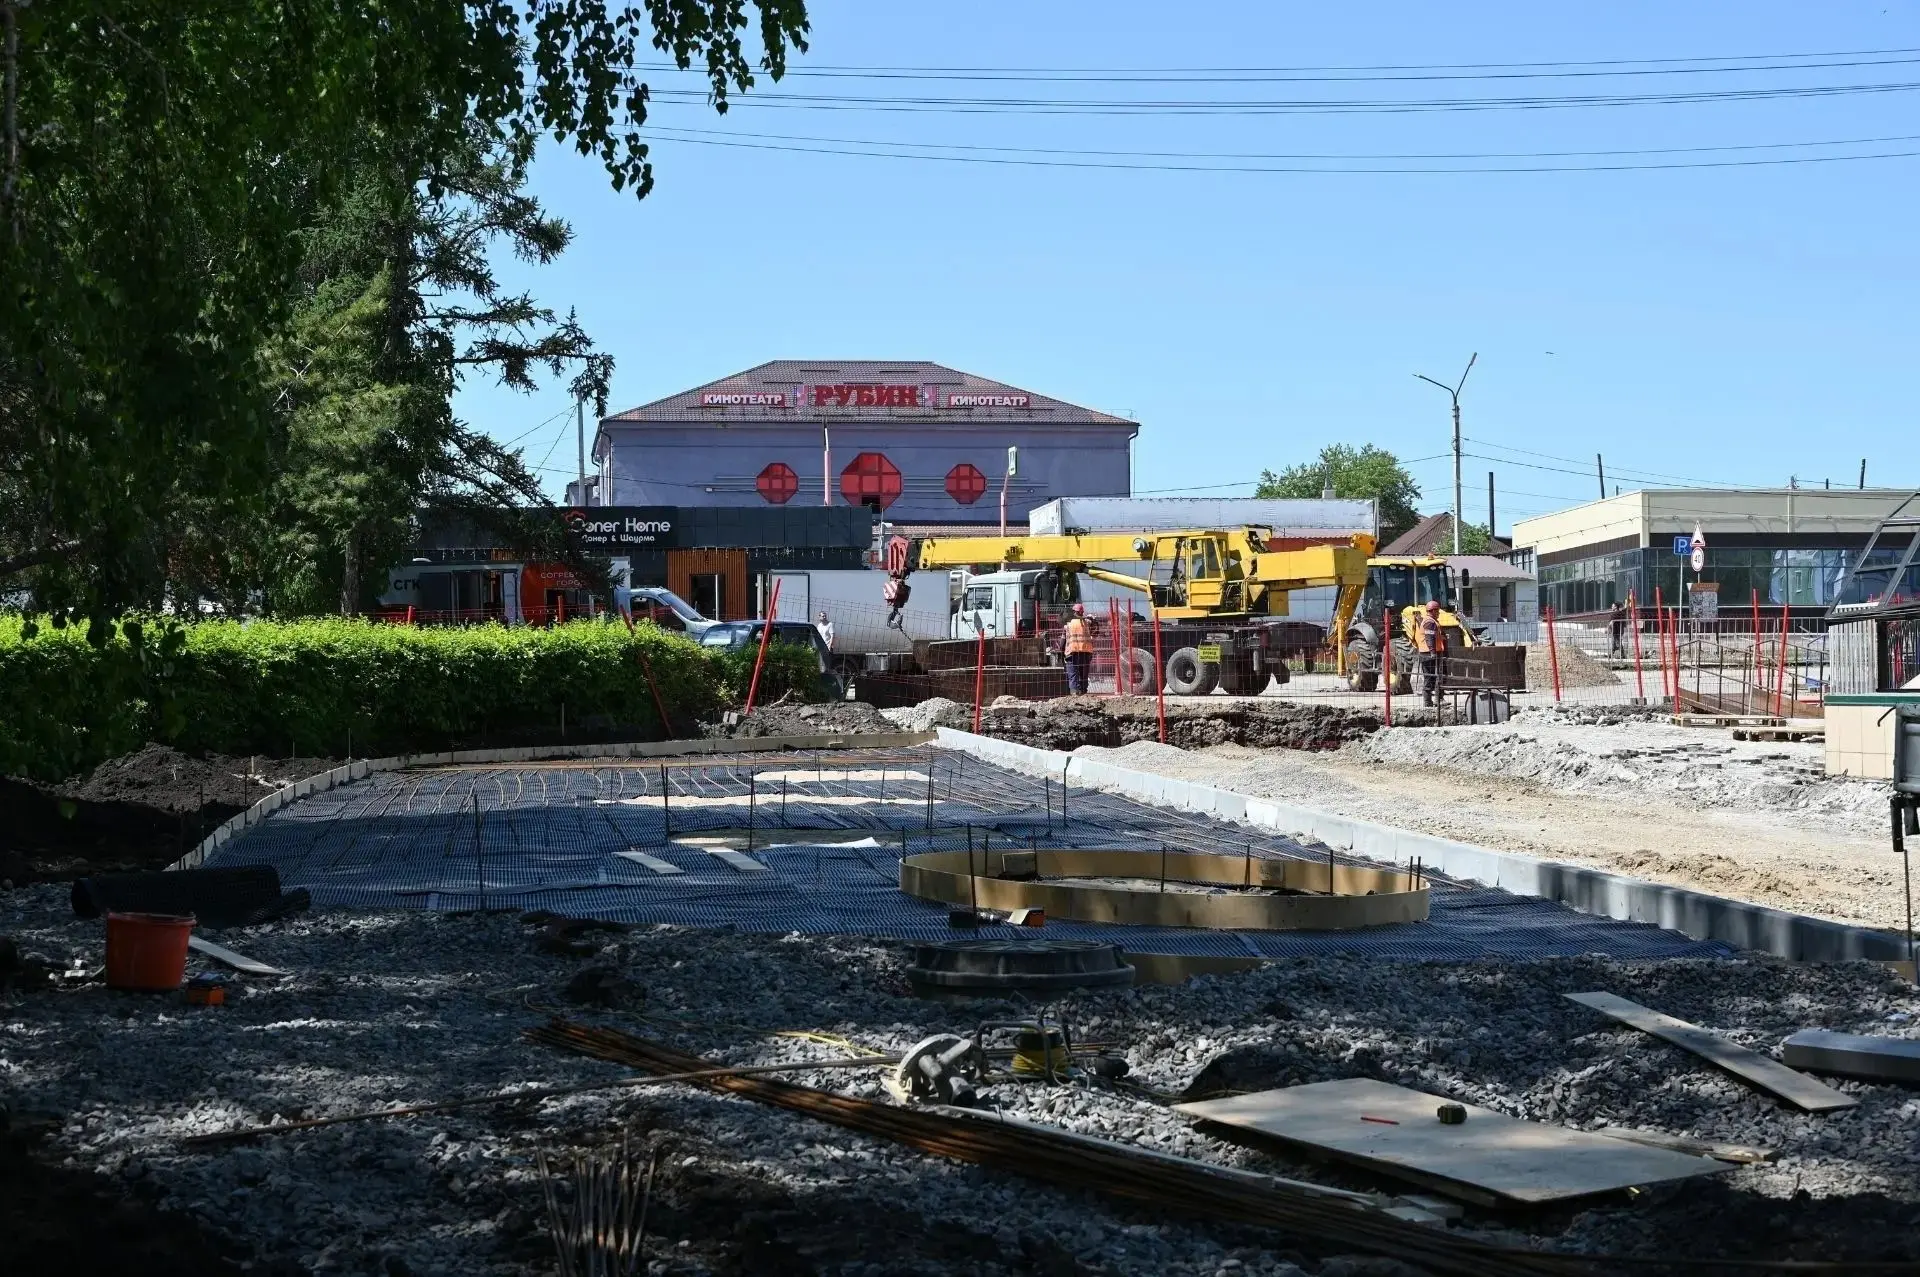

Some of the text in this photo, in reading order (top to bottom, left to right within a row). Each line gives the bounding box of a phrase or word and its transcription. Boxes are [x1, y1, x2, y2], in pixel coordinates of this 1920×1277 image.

[704, 394, 782, 405] КИНОТЕАТР
[815, 385, 918, 407] РУБИН
[951, 396, 1027, 406] КИНОТЕАТР
[625, 518, 671, 532] Home
[620, 534, 655, 543] Шаурма
[1694, 554, 1701, 564] 40
[393, 579, 420, 591] СГК
